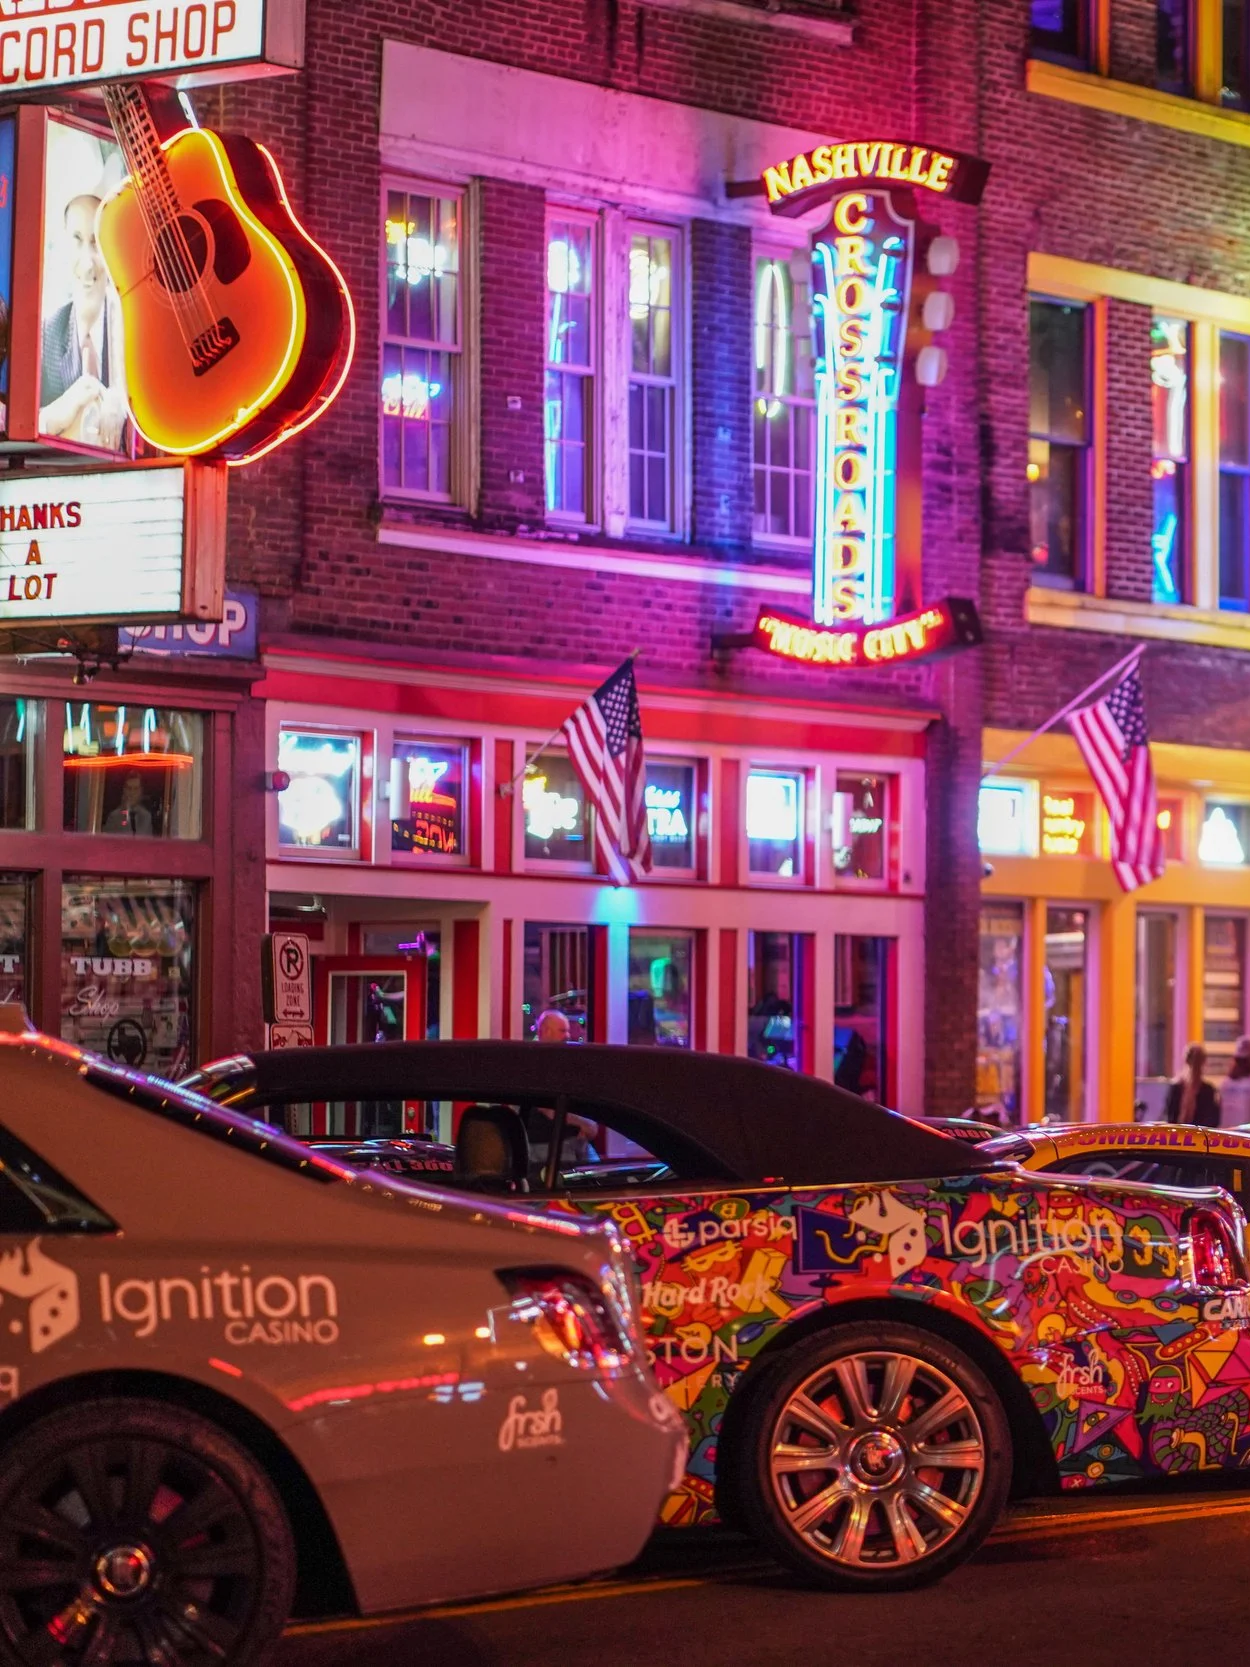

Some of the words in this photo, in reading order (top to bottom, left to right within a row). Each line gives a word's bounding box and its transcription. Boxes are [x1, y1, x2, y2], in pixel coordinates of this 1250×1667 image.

[126, 0, 236, 67] SHOP
[762, 141, 954, 203] NASHVILLE
[832, 192, 876, 619] CROSSROADS
[25, 539, 42, 565] A
[8, 573, 57, 600] LOT
[70, 957, 152, 976] TUBB
[281, 982, 304, 994] LOADING
[286, 995, 301, 1007] ZONE
[699, 1211, 798, 1246] parsiq
[941, 1208, 1122, 1268] Ignition
[1039, 1256, 1124, 1274] CASINO
[100, 1264, 338, 1337] Ignition
[642, 1278, 707, 1308] Hard
[710, 1275, 771, 1308] Rock
[224, 1319, 339, 1345] CASINO
[1056, 1349, 1103, 1398] frsh
[499, 1388, 562, 1451] frsh
